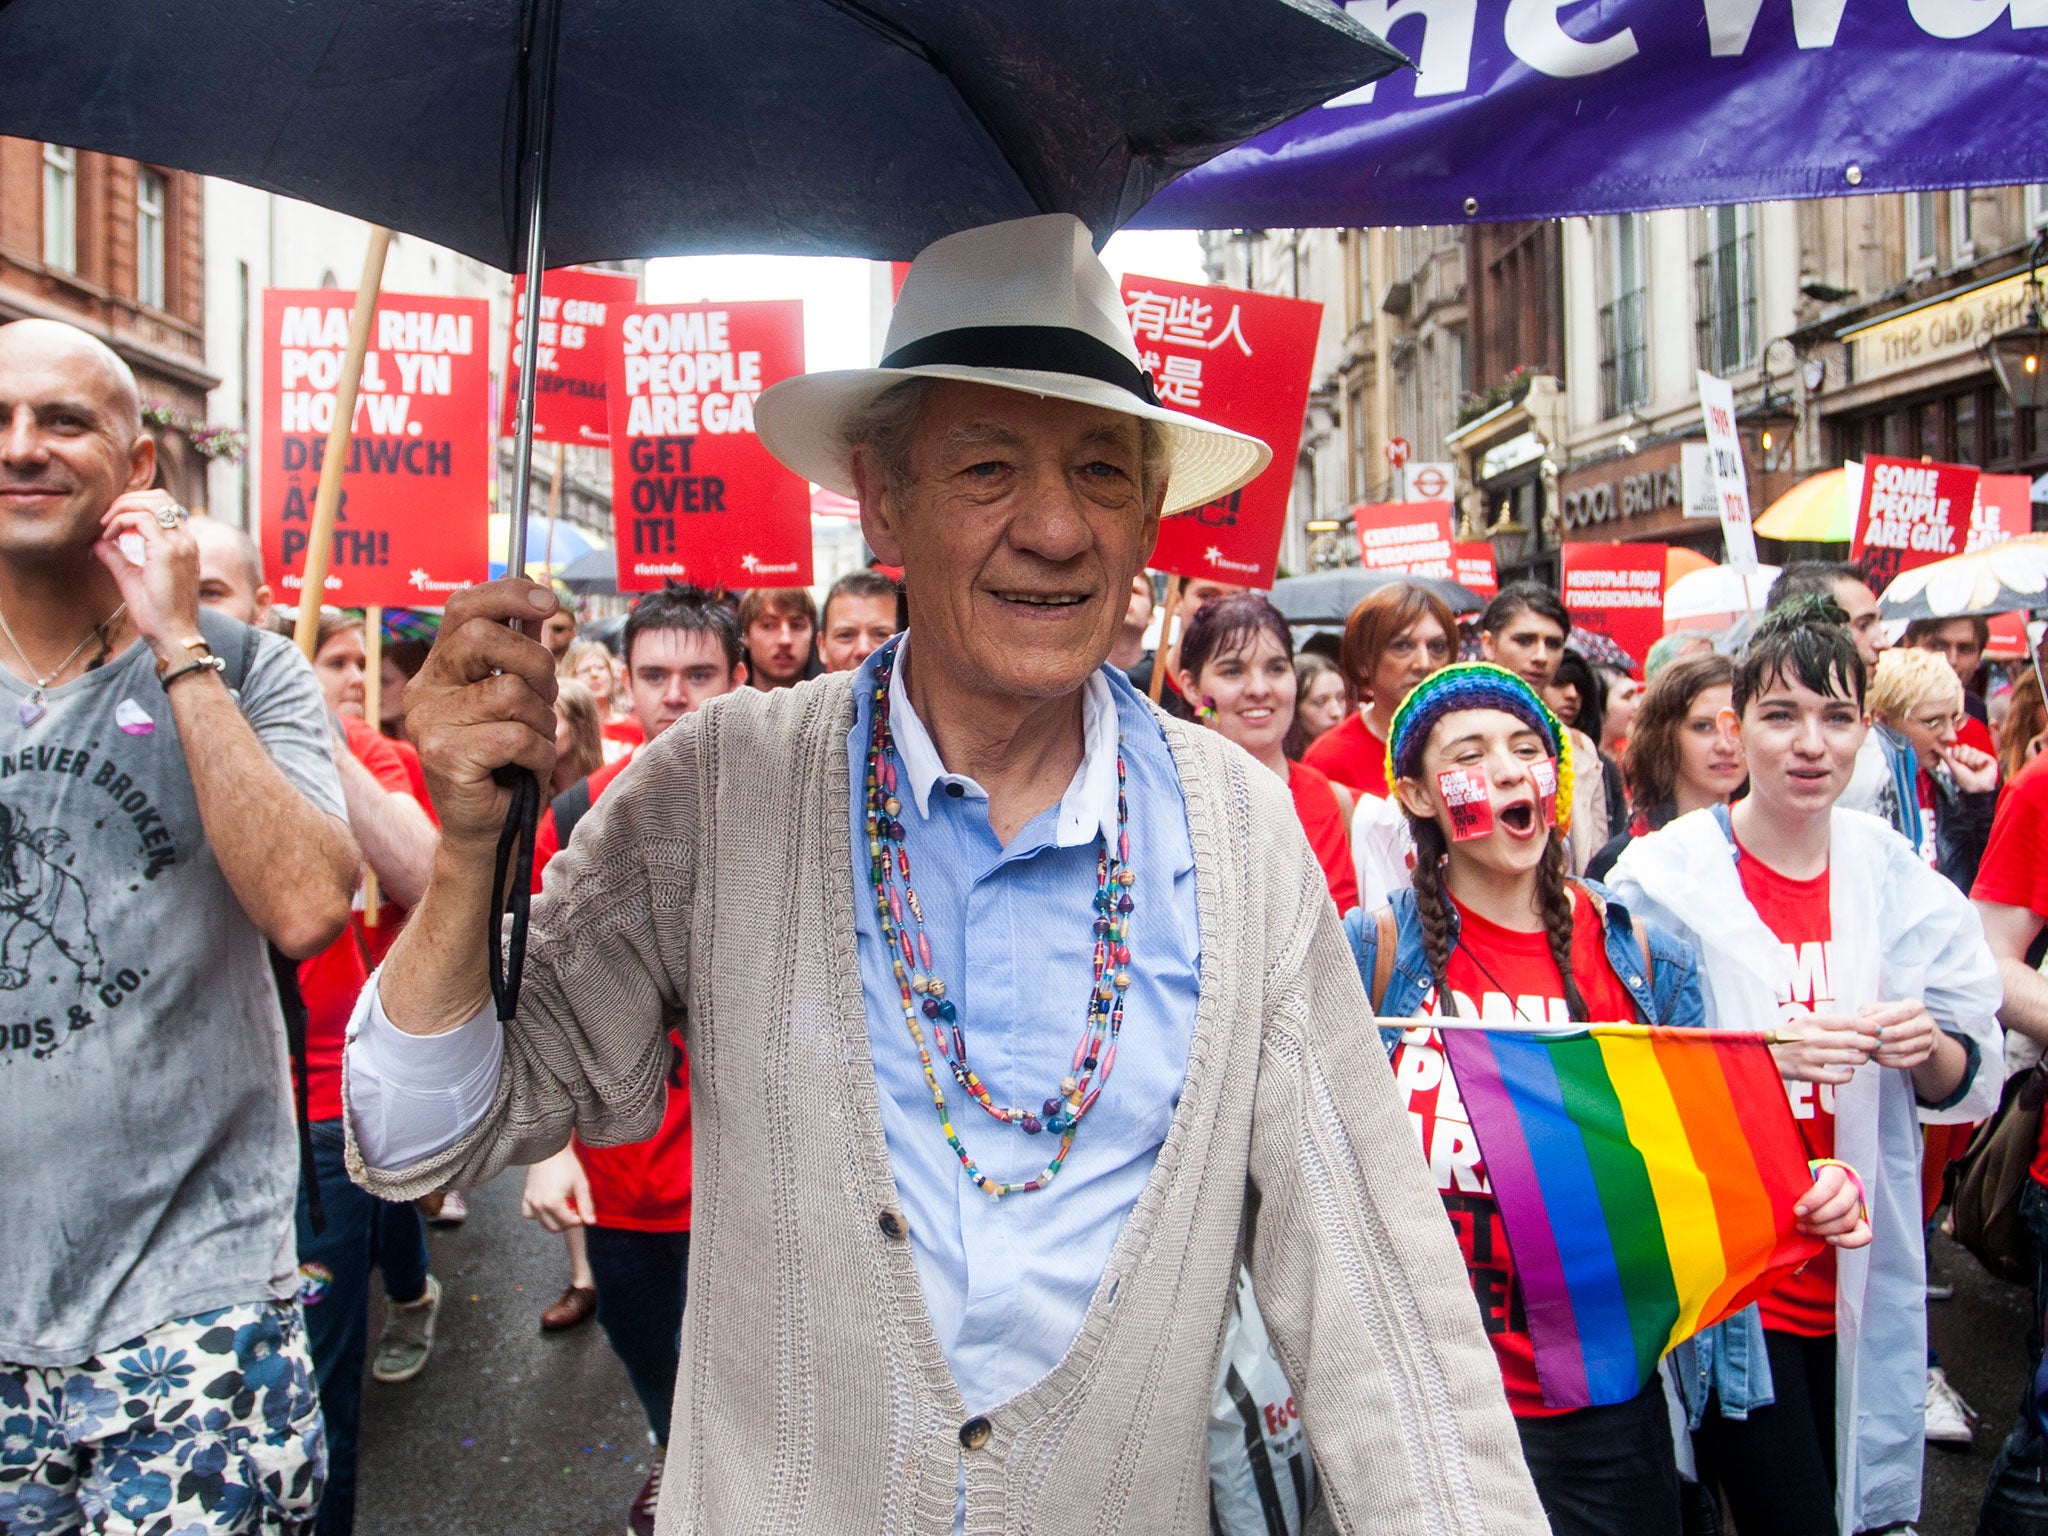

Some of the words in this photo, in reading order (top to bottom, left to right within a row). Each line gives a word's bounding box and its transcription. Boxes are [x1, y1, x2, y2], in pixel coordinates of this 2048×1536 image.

[378, 310, 472, 355] RHAI
[622, 311, 730, 355] SOME
[1126, 289, 1253, 358] 有些人
[282, 349, 386, 391] POL
[394, 353, 451, 396] YN
[624, 350, 761, 397] PEOPLE
[626, 393, 699, 436] ARE
[701, 391, 760, 435] GA
[629, 436, 695, 475] GET
[630, 475, 727, 514] OVER
[1873, 464, 1939, 498] SOME
[1869, 491, 1951, 525] PEOPLE
[282, 529, 389, 566] PTH!
[633, 518, 677, 555] IT!
[1863, 518, 1911, 549] ARE
[1911, 522, 1956, 554] GAY.
[424, 579, 473, 591] Stonewall
[756, 562, 798, 573] Stonewall
[0, 745, 91, 778] NEVER
[92, 760, 178, 880] BROKEN
[67, 1004, 96, 1031] &
[98, 968, 150, 1009] CO.
